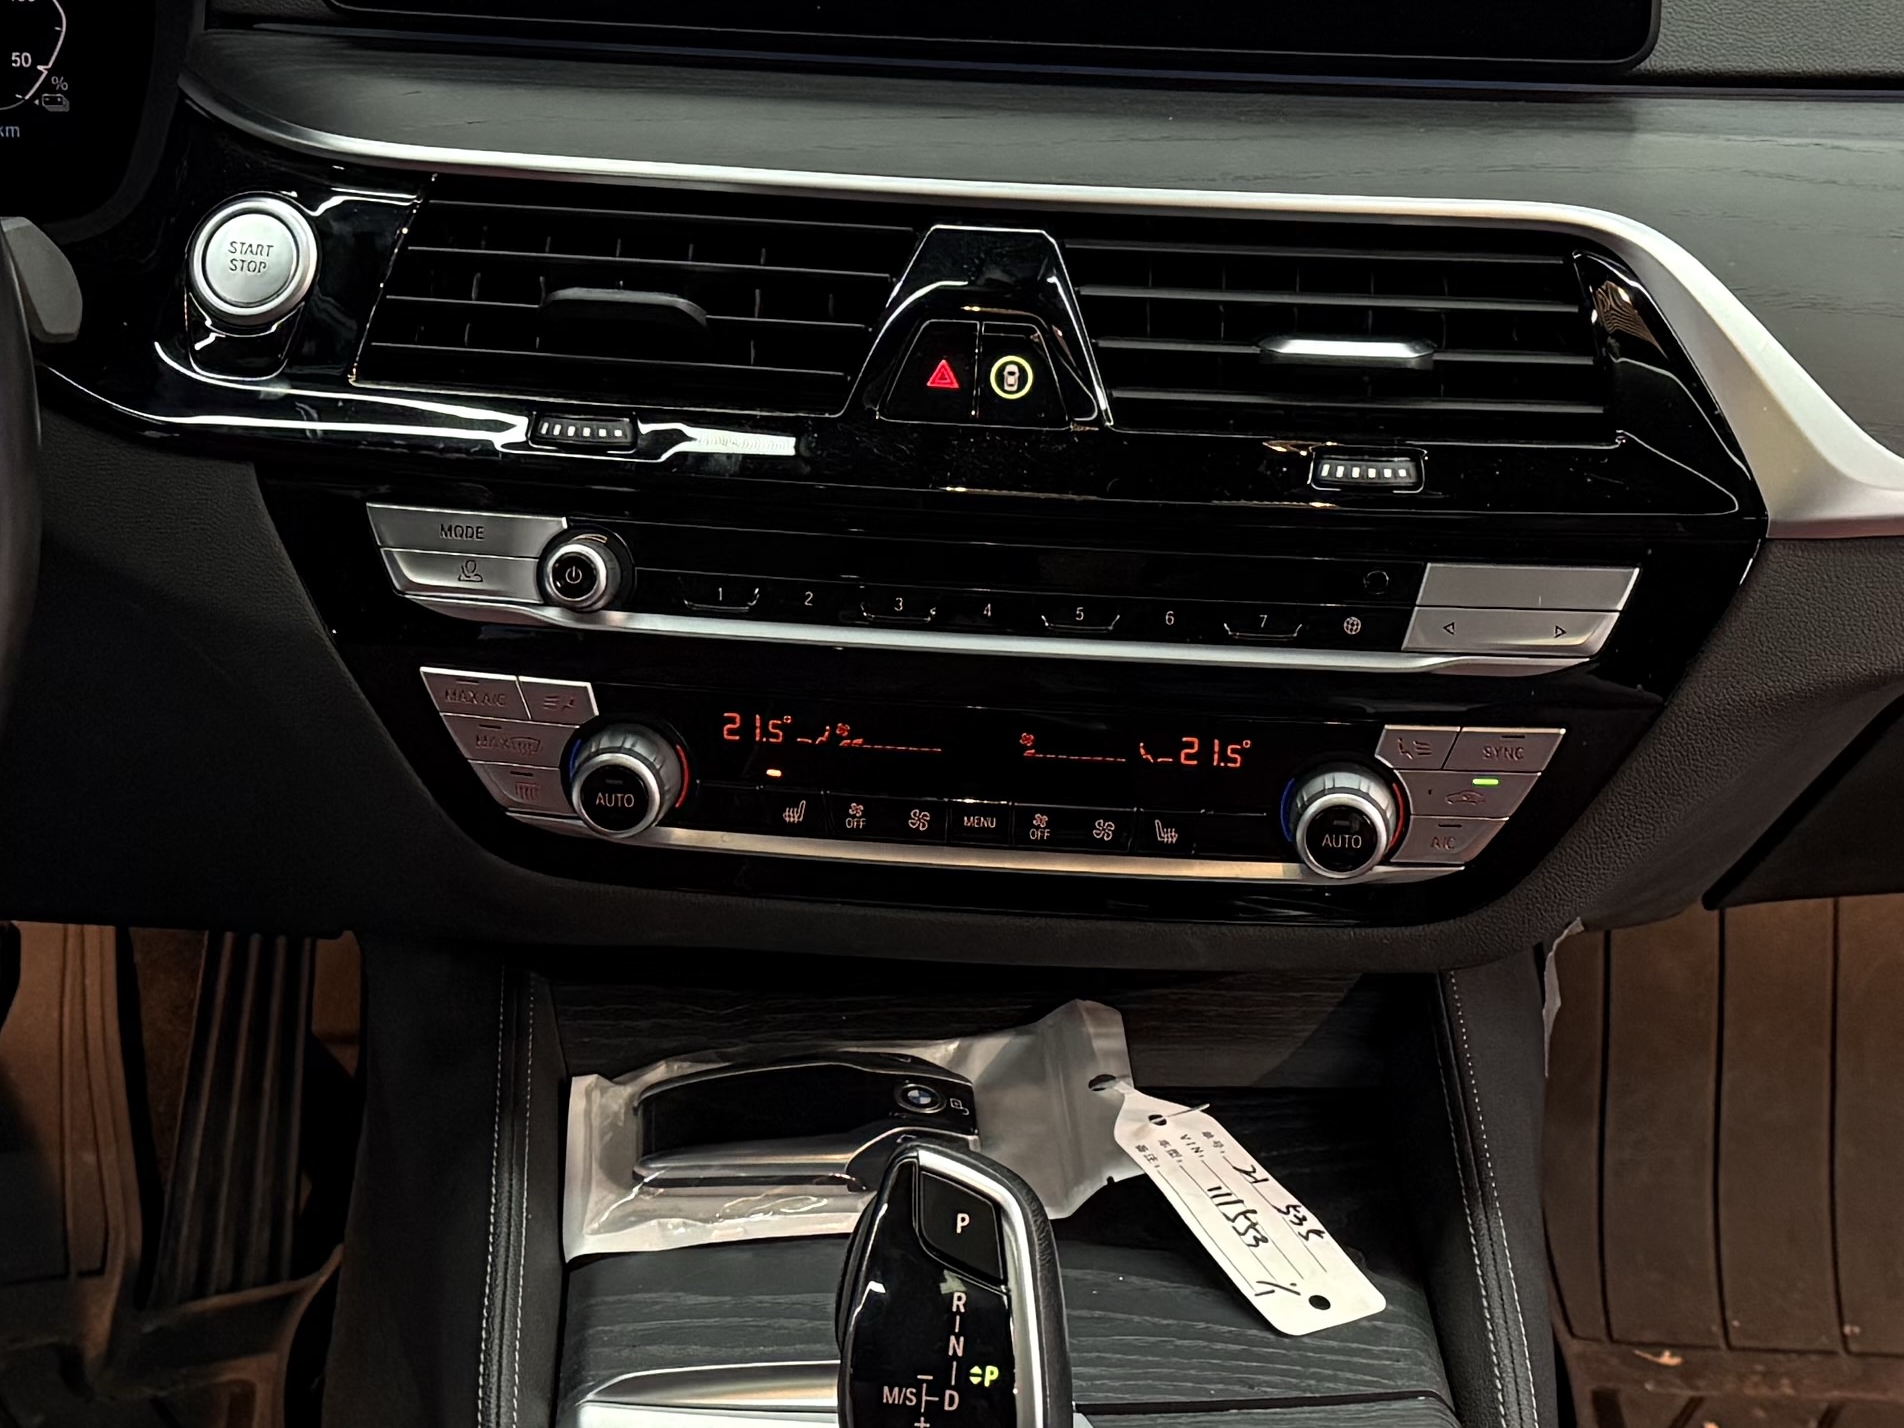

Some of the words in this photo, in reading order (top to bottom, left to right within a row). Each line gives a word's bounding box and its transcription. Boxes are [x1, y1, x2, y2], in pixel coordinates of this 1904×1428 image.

[11, 52, 31, 67] 50
[228, 241, 274, 257] START
[229, 258, 267, 273] STOP
[440, 523, 484, 540] MODE
[717, 587, 724, 601] 1
[804, 591, 813, 606] 2
[895, 597, 903, 612] 3
[983, 603, 992, 617] 4
[1075, 607, 1084, 622] 5
[1165, 611, 1175, 626] 6
[1259, 614, 1268, 628] 7
[1482, 746, 1525, 761] SYNC
[596, 791, 634, 808] AUTO
[845, 816, 866, 829] OFF
[963, 814, 996, 829] MENU
[1029, 826, 1051, 840] OFF
[1321, 832, 1363, 849] AUTO
[956, 1213, 970, 1234] P
[952, 1292, 966, 1313] R
[948, 1336, 964, 1357] N
[984, 1365, 999, 1387] P
[883, 1386, 916, 1406] M/S
[944, 1390, 959, 1411] D
